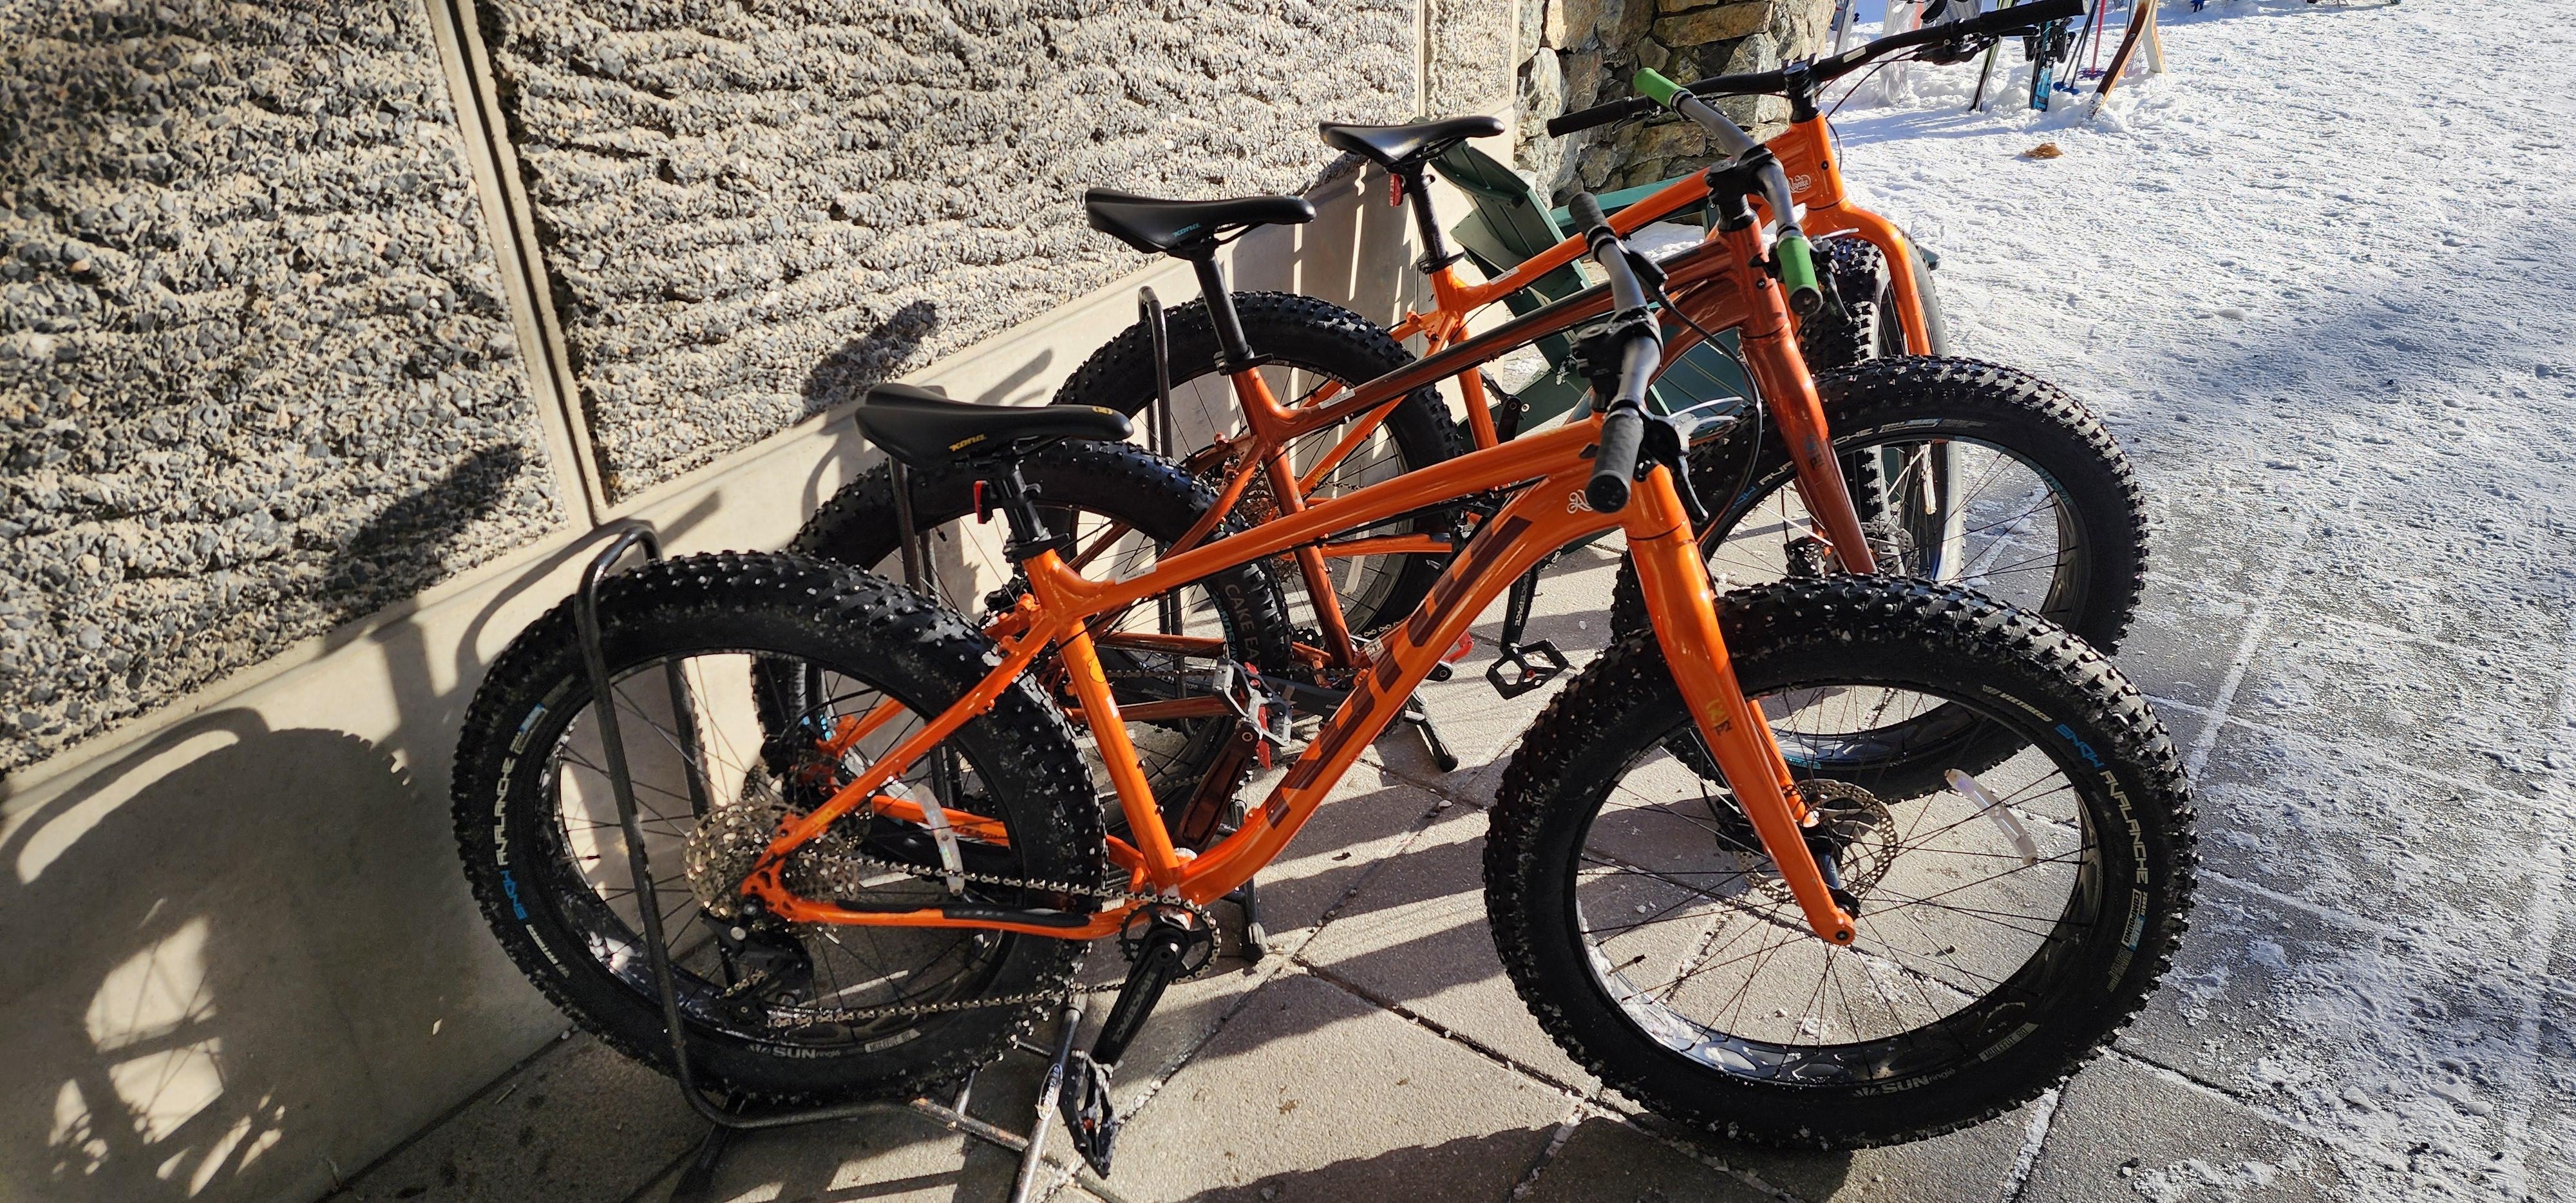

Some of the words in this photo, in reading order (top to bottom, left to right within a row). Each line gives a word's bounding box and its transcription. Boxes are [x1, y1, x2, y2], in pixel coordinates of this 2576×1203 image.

[1225, 583, 1255, 632] CAKE
[494, 757, 516, 866] AVALANCHE
[2099, 770, 2149, 884] AVALANCHE
[2123, 891, 2141, 945] COMPOUND
